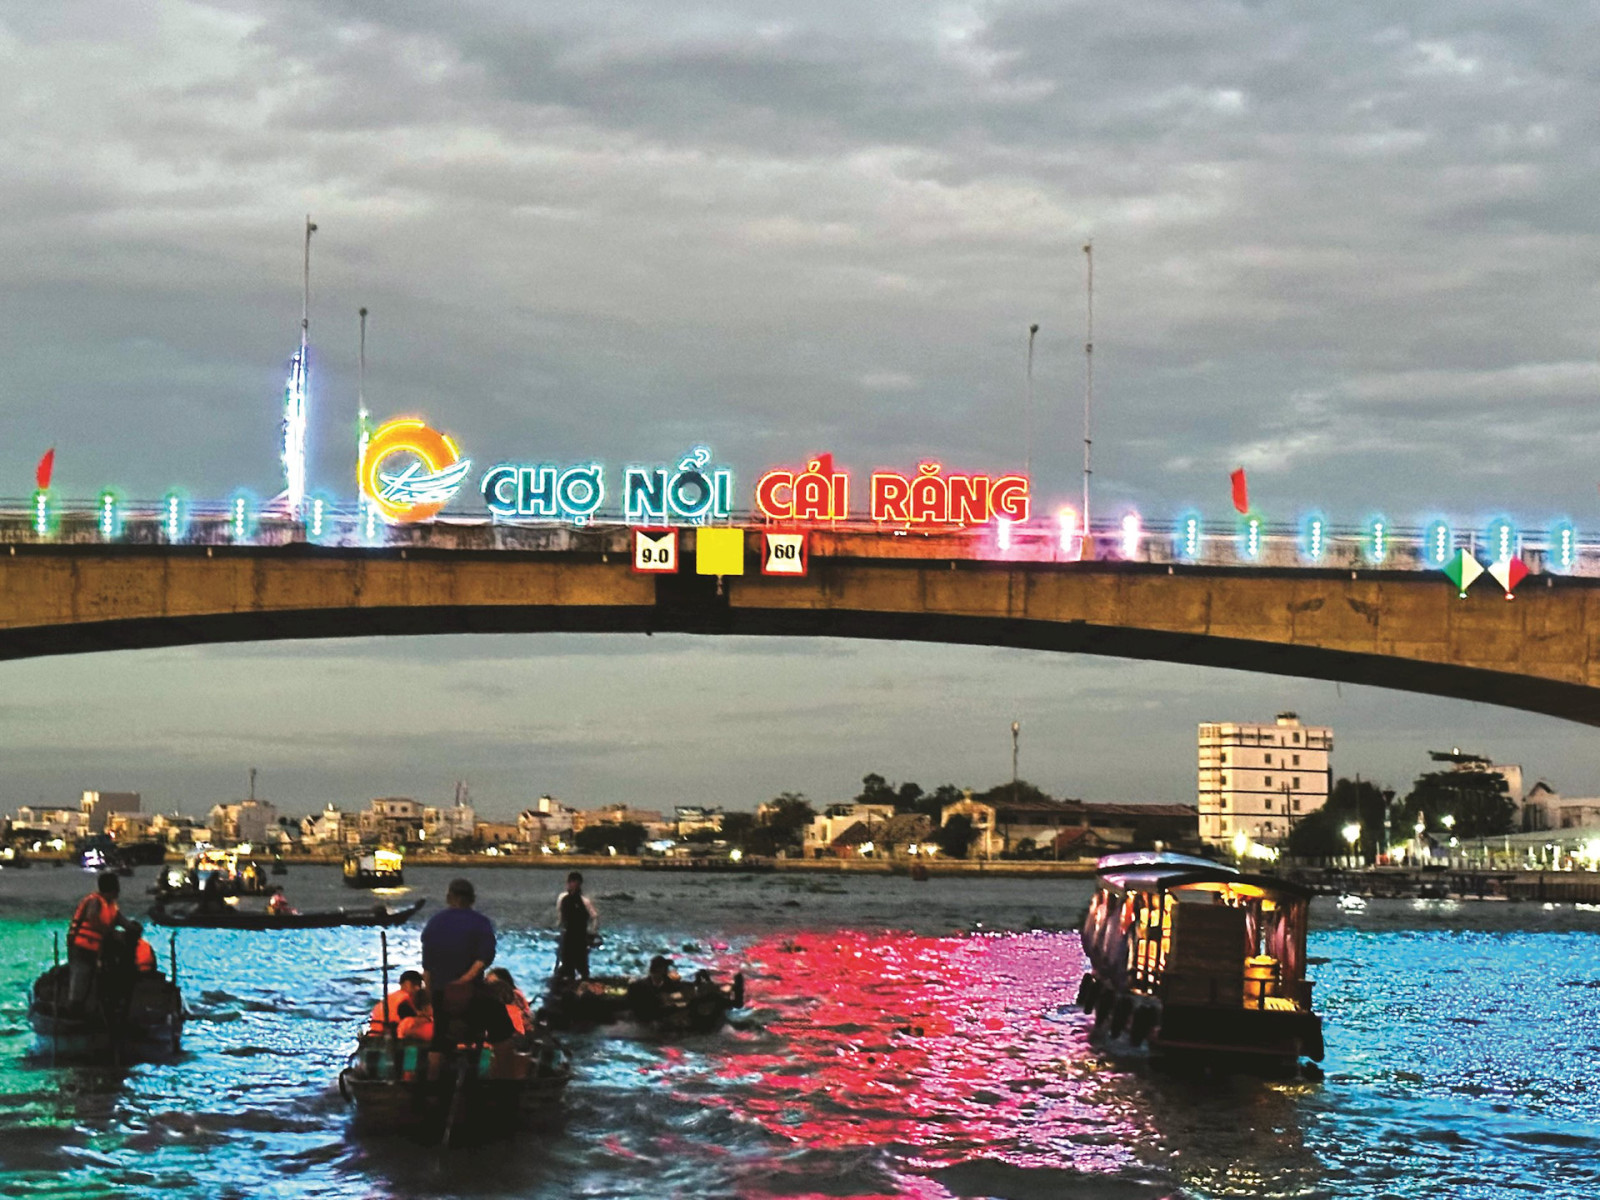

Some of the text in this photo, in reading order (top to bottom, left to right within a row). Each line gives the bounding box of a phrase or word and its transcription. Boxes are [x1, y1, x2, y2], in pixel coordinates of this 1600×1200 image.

[481, 448, 1030, 526] CHỢ NỔI CÁI RĂNG
[641, 548, 669, 563] 9.0
[774, 544, 795, 559] 60
